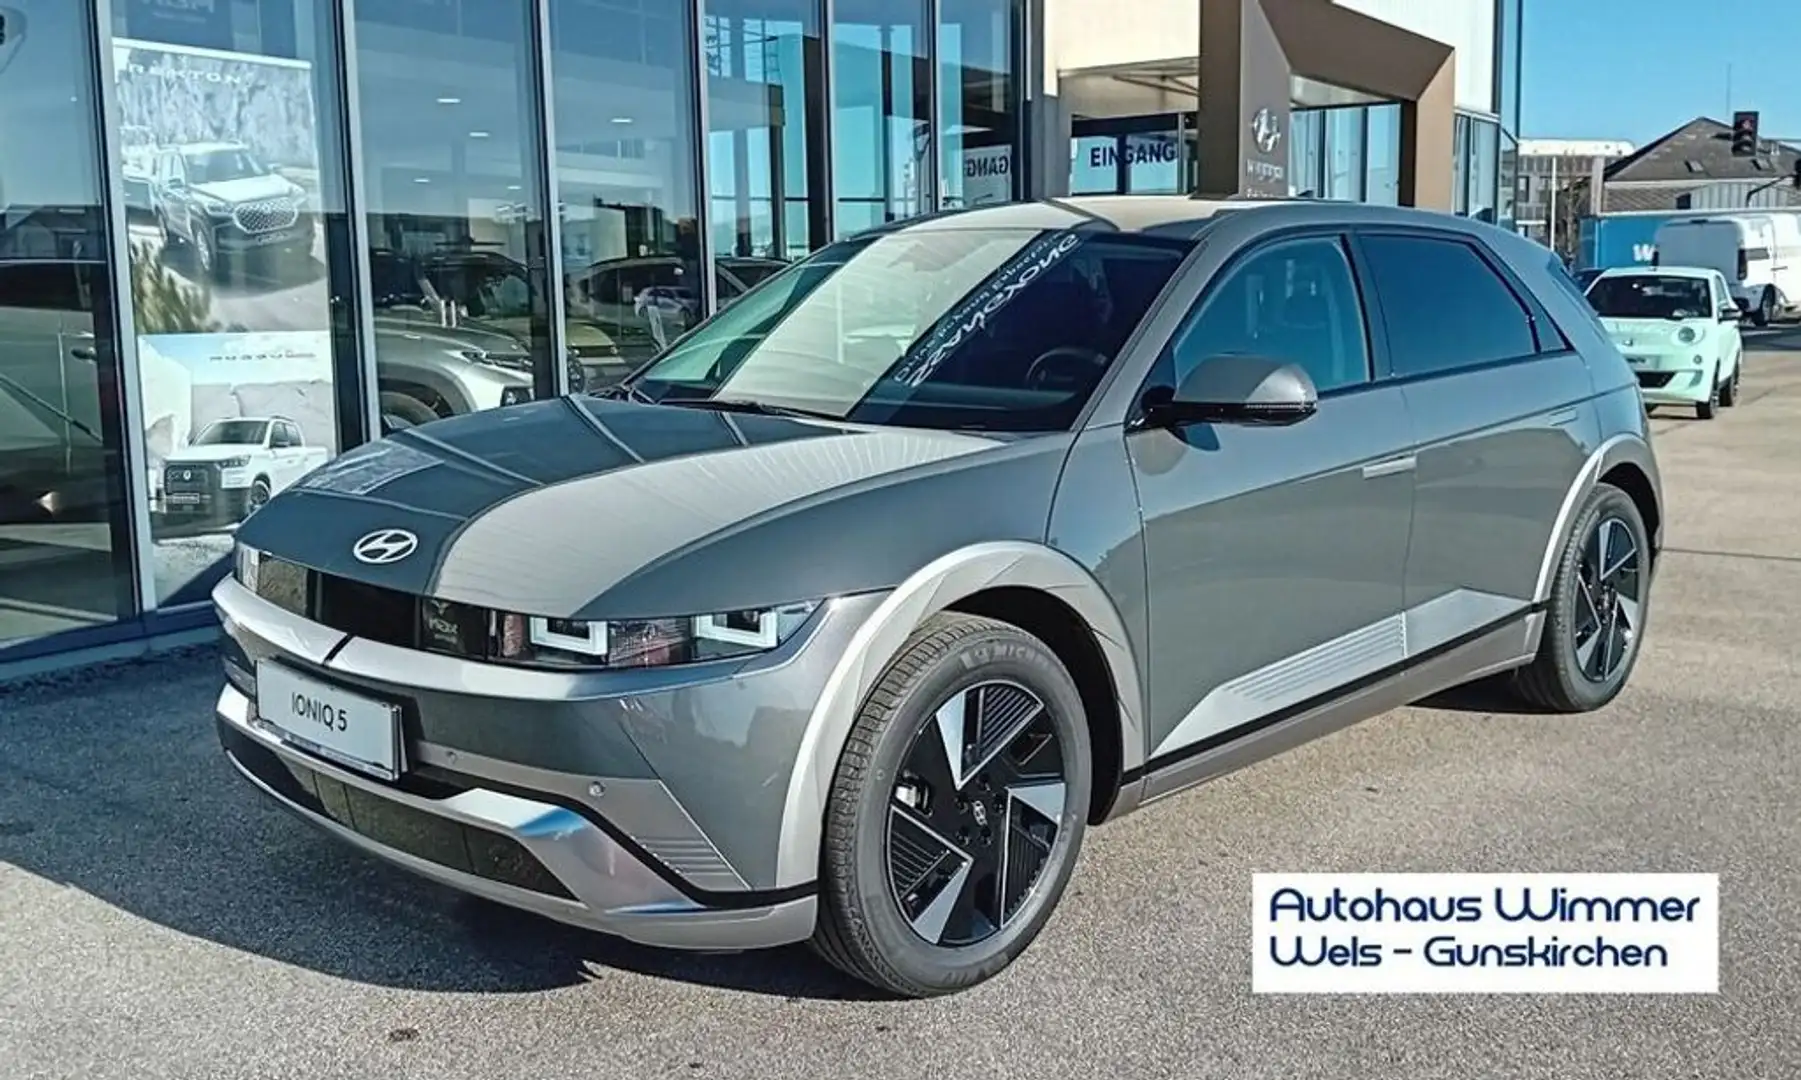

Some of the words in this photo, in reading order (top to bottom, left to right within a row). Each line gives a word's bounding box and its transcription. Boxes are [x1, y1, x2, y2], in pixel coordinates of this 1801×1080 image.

[1090, 143, 1176, 167] EINGANG
[291, 691, 334, 732] IONIQ
[337, 708, 348, 732] 5
